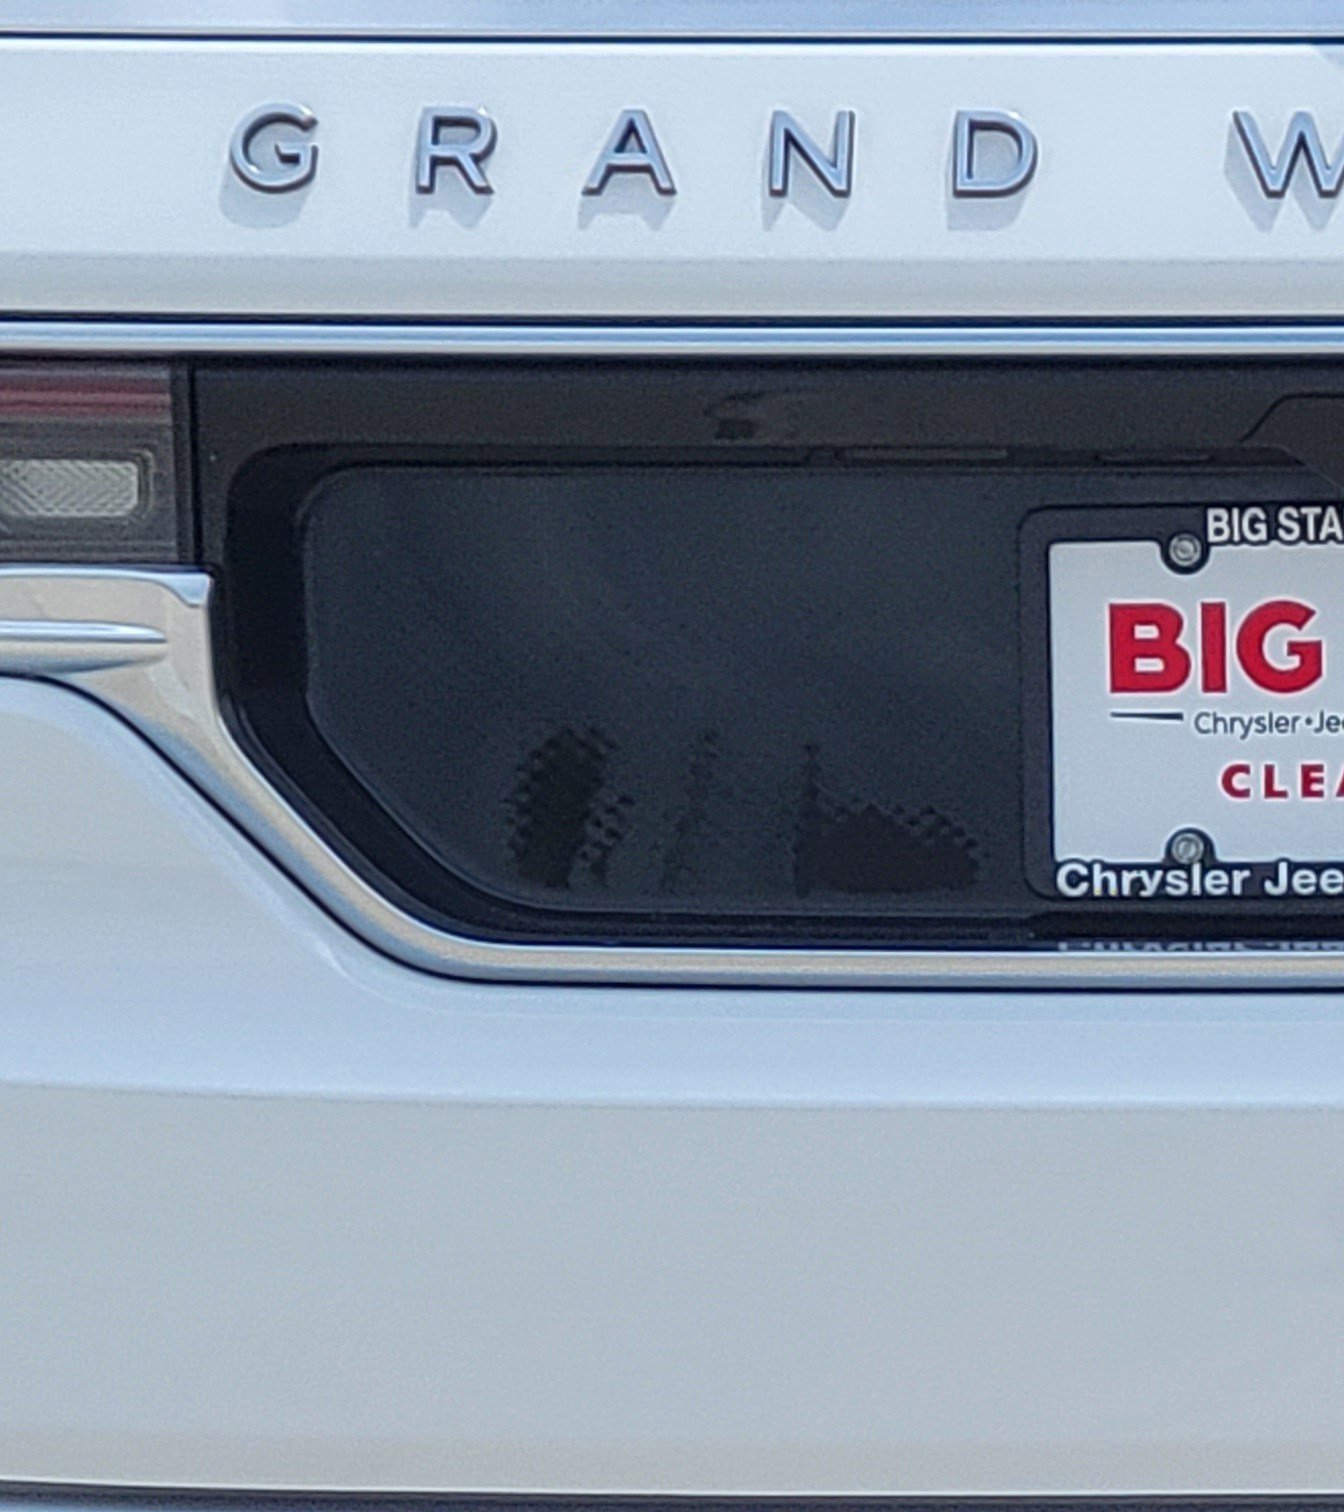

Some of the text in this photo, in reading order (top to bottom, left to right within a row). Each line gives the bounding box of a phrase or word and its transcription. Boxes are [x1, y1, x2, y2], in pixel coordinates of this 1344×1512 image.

[228, 102, 1040, 201] GRAND
[1205, 506, 1268, 545] BIG
[1108, 600, 1324, 694] BIG
[1055, 860, 1251, 898] Chrysler
